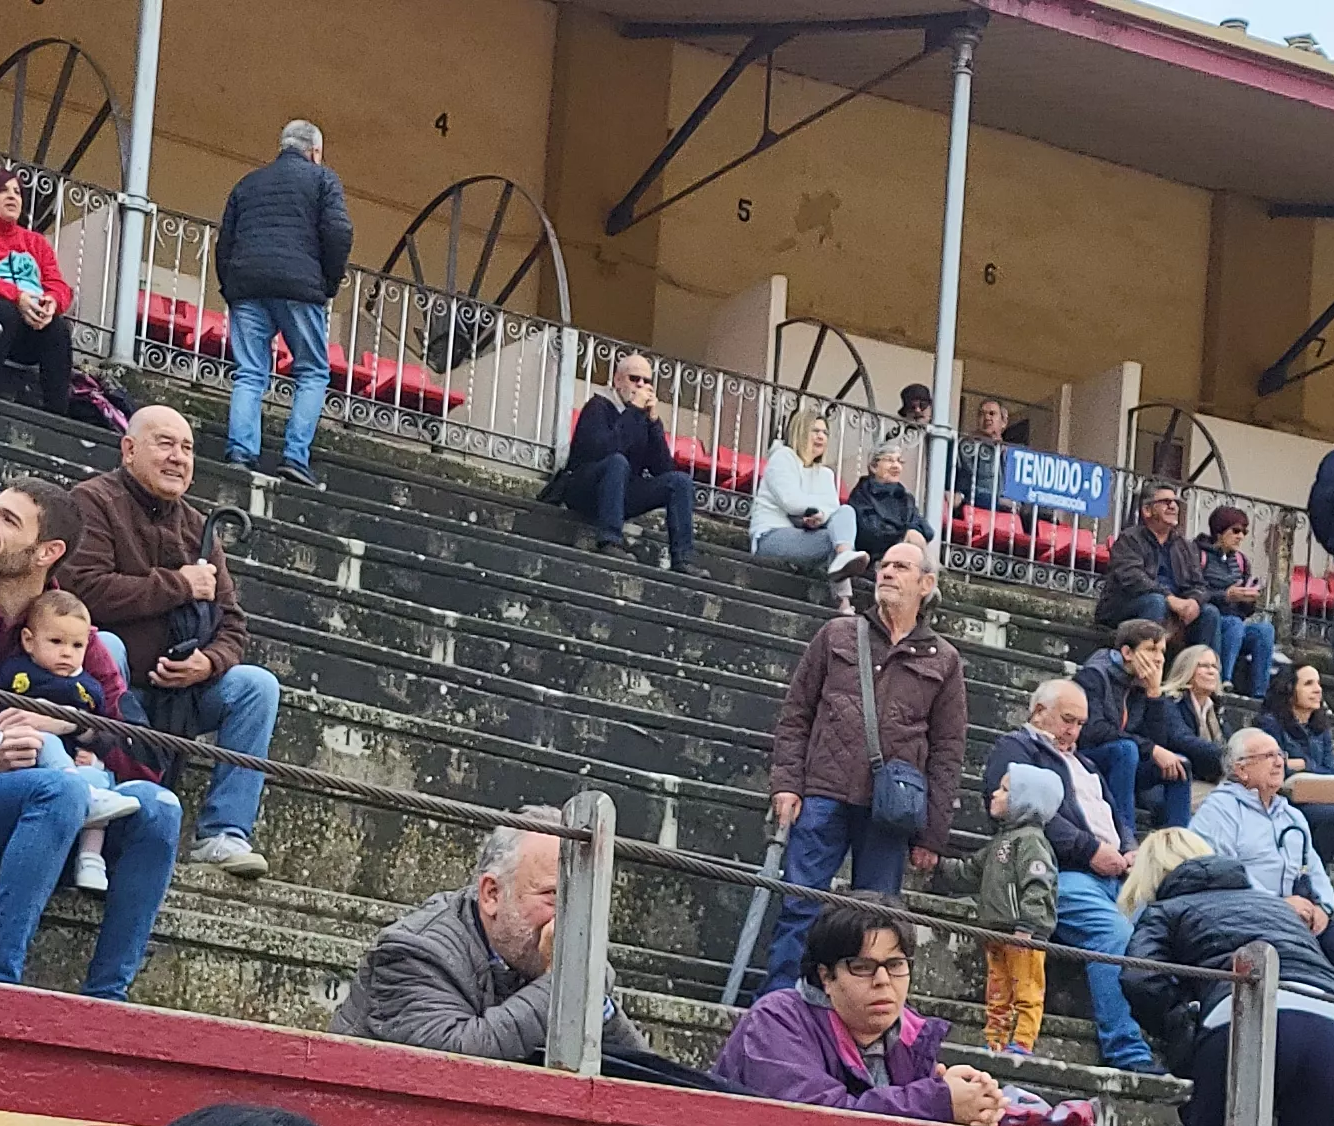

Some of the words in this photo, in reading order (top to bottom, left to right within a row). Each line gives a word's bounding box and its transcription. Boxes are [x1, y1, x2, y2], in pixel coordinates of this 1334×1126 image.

[434, 112, 448, 137] 4
[737, 197, 753, 222] 5
[984, 262, 996, 286] 6
